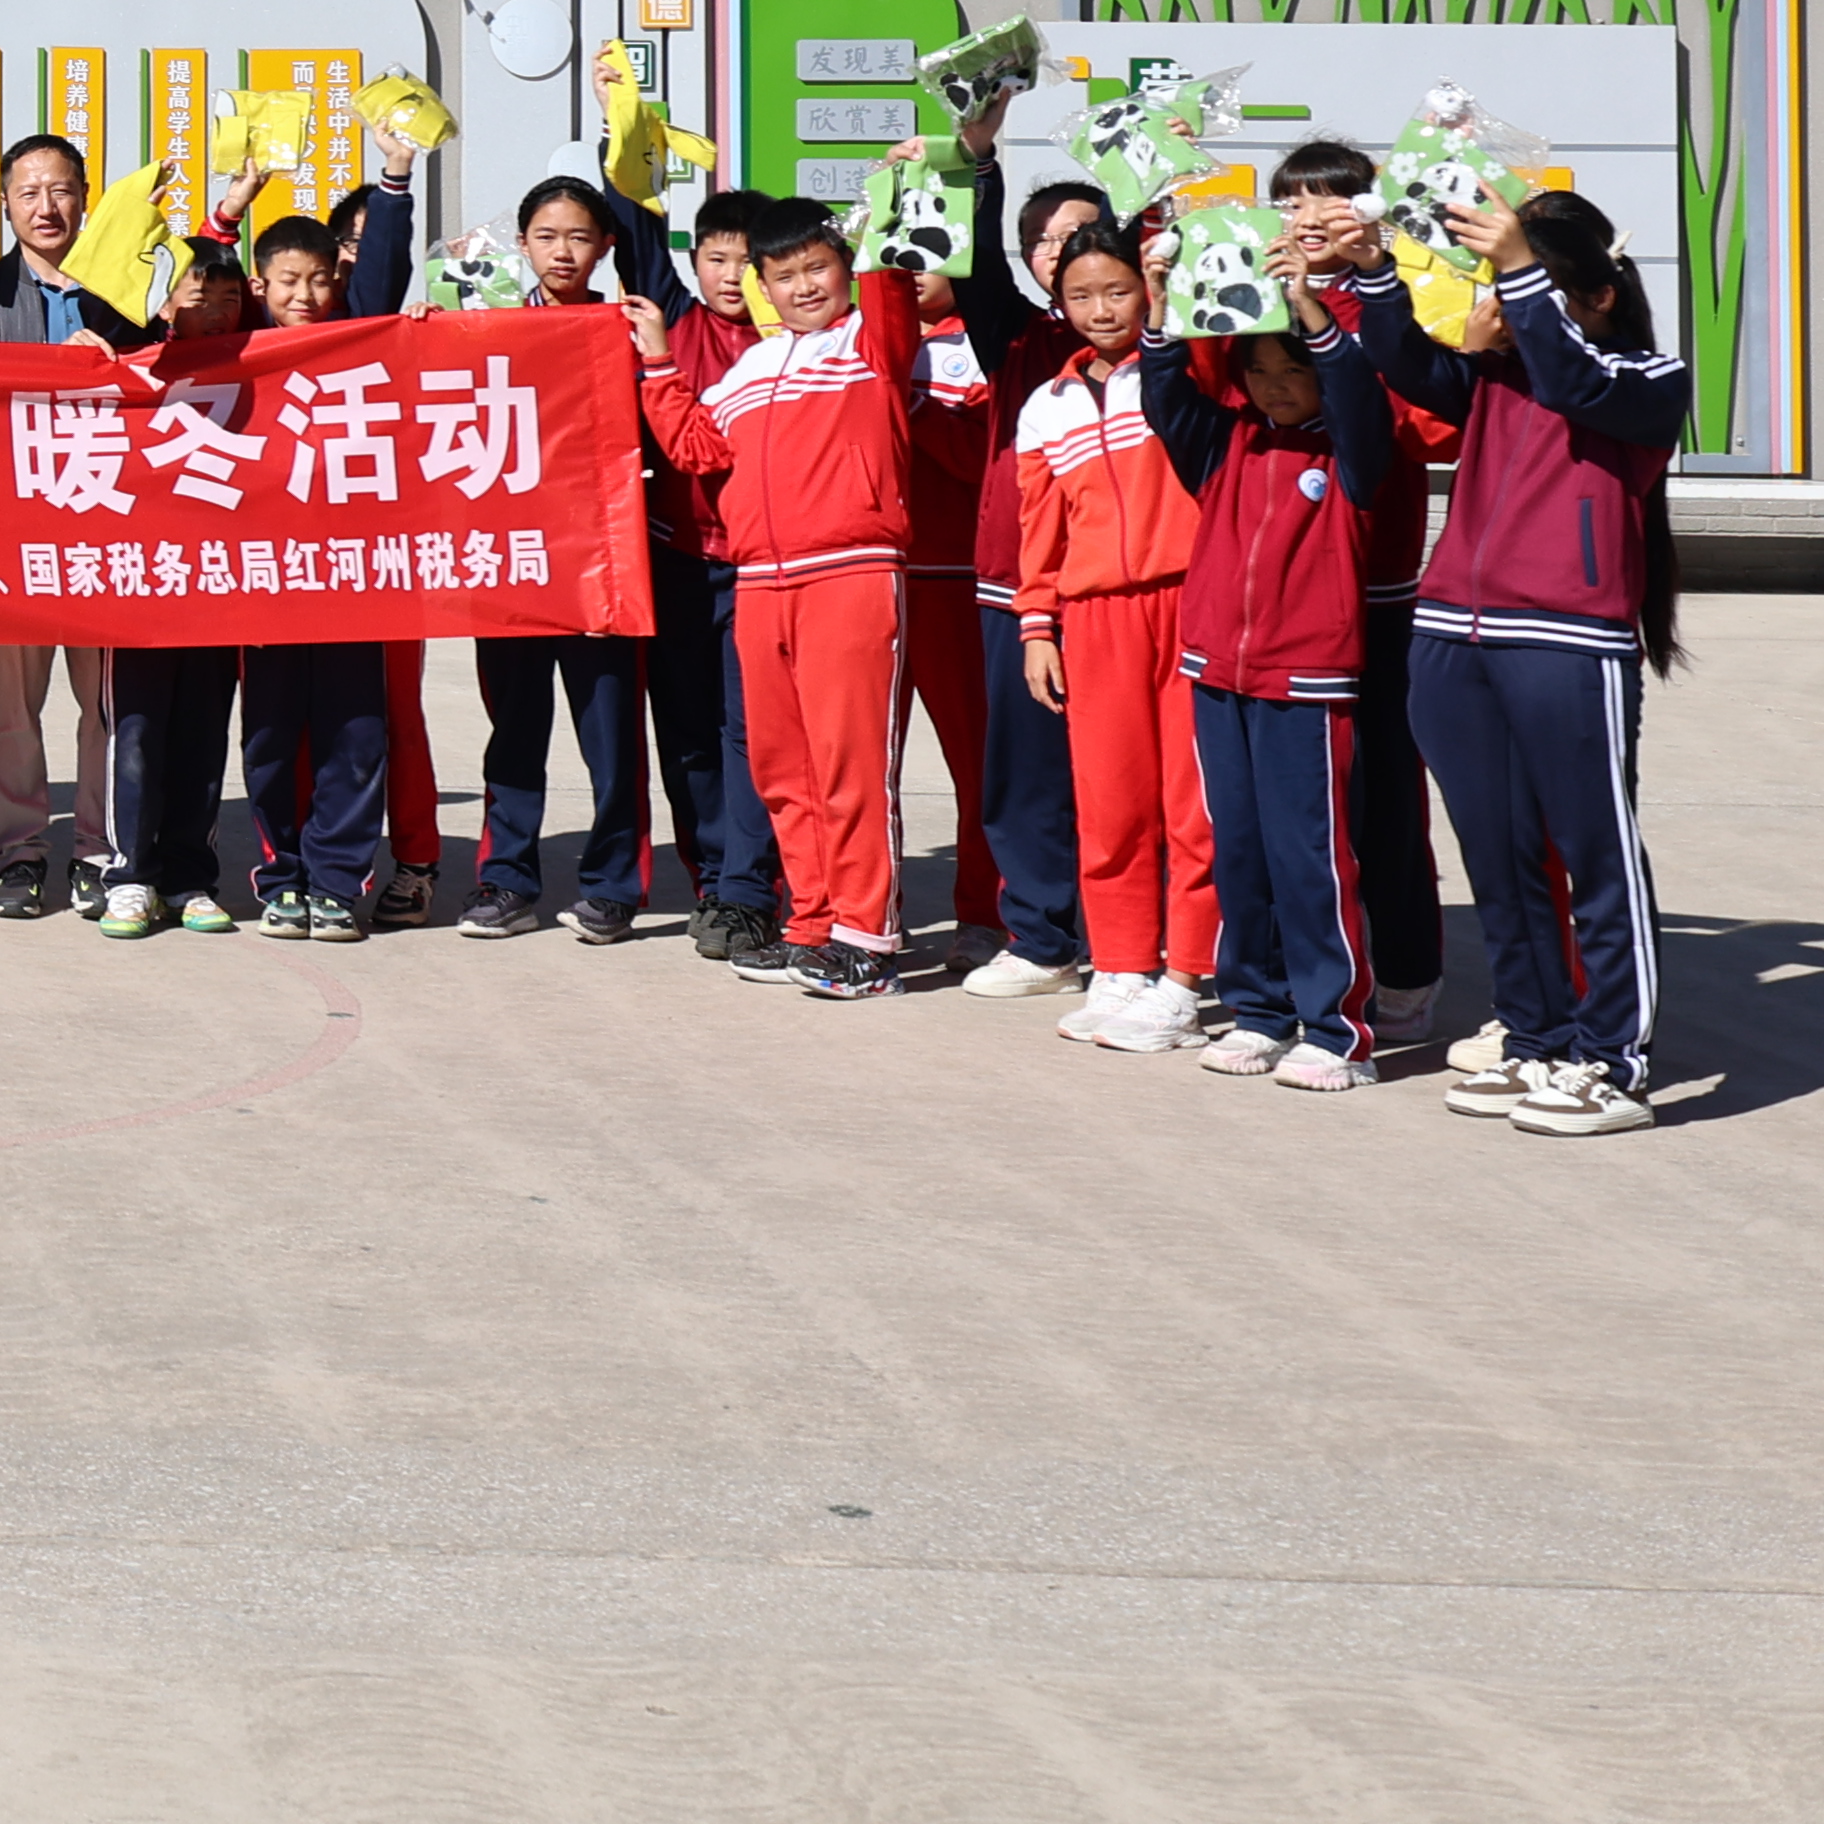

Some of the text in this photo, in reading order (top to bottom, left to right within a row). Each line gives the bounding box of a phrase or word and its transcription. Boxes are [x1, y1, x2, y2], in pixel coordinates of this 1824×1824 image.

[810, 45, 906, 76] 发现美
[809, 105, 906, 136] 欣赏美
